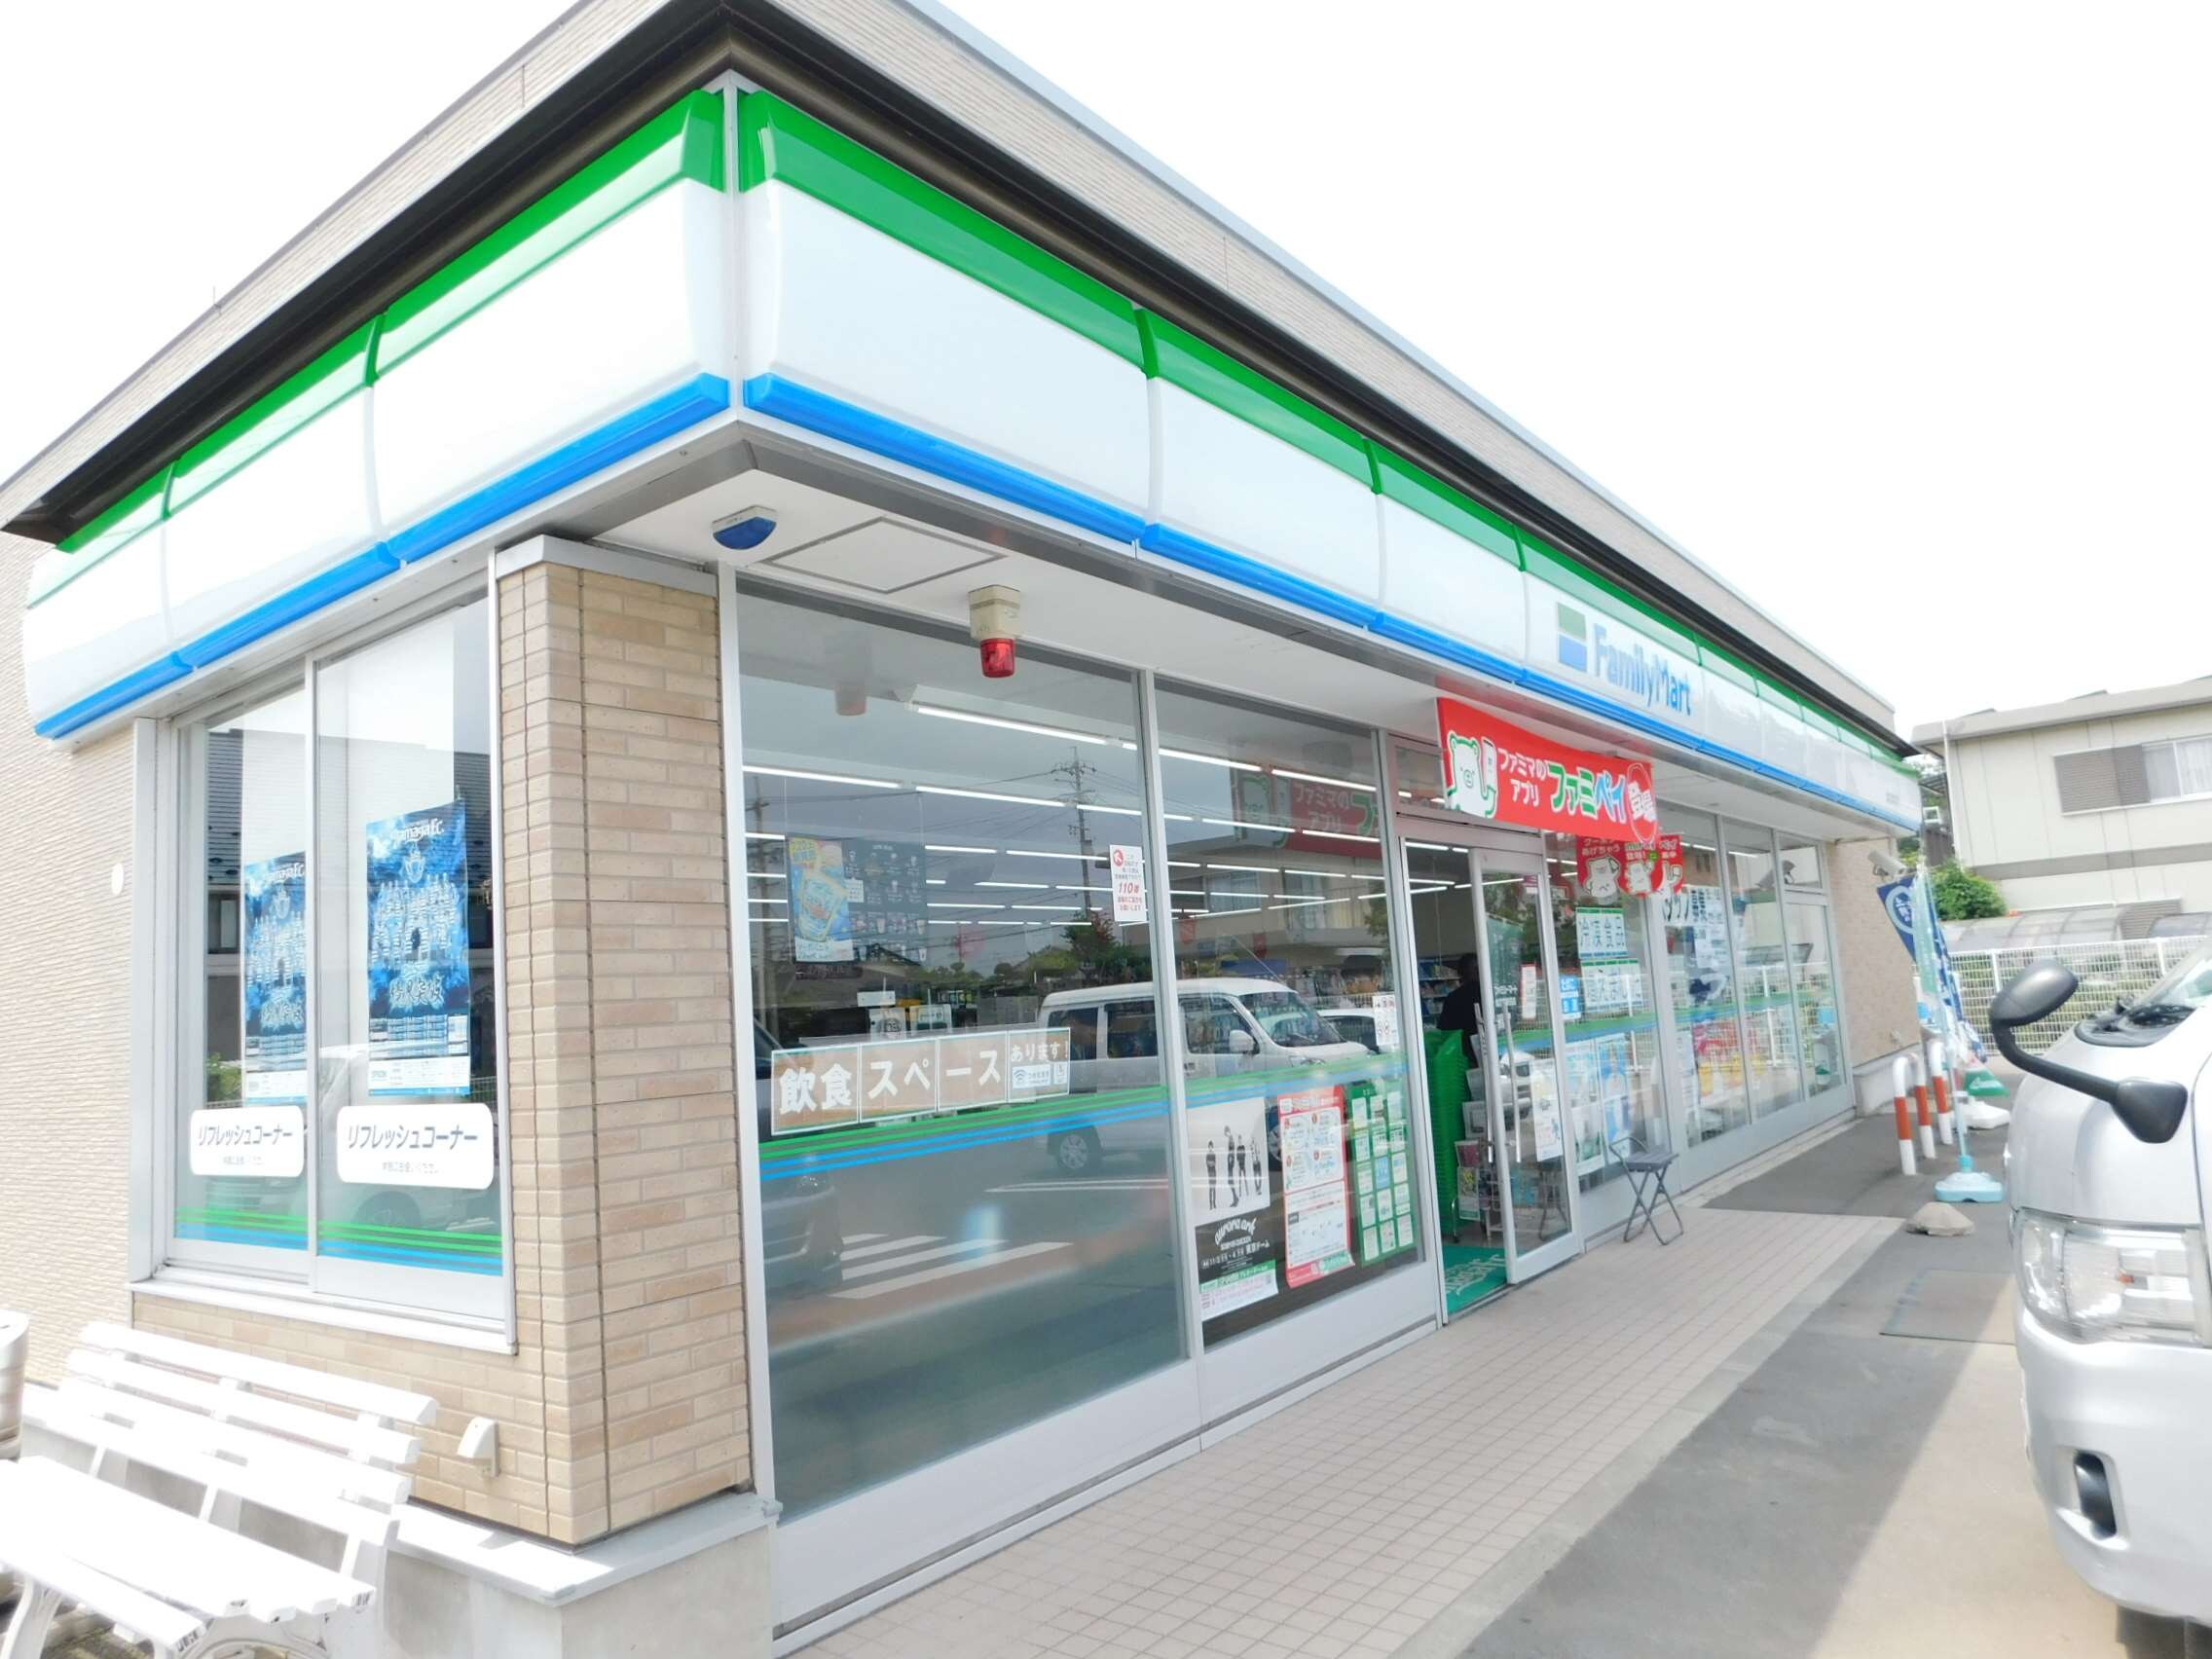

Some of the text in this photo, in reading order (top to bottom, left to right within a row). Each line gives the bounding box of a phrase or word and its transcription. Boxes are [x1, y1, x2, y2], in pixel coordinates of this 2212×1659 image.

[1594, 623, 1691, 716] FamilyMart
[1497, 748, 1547, 781] ファミマの
[1511, 778, 1539, 807] アプリ
[1548, 763, 1627, 824] ファミペイ
[1011, 1040, 1068, 1063] あります!
[779, 1050, 1001, 1116] 飲食スペース
[198, 1124, 293, 1147] リフレッシュコーナー
[348, 1124, 478, 1151] リフレッシュコーナー
